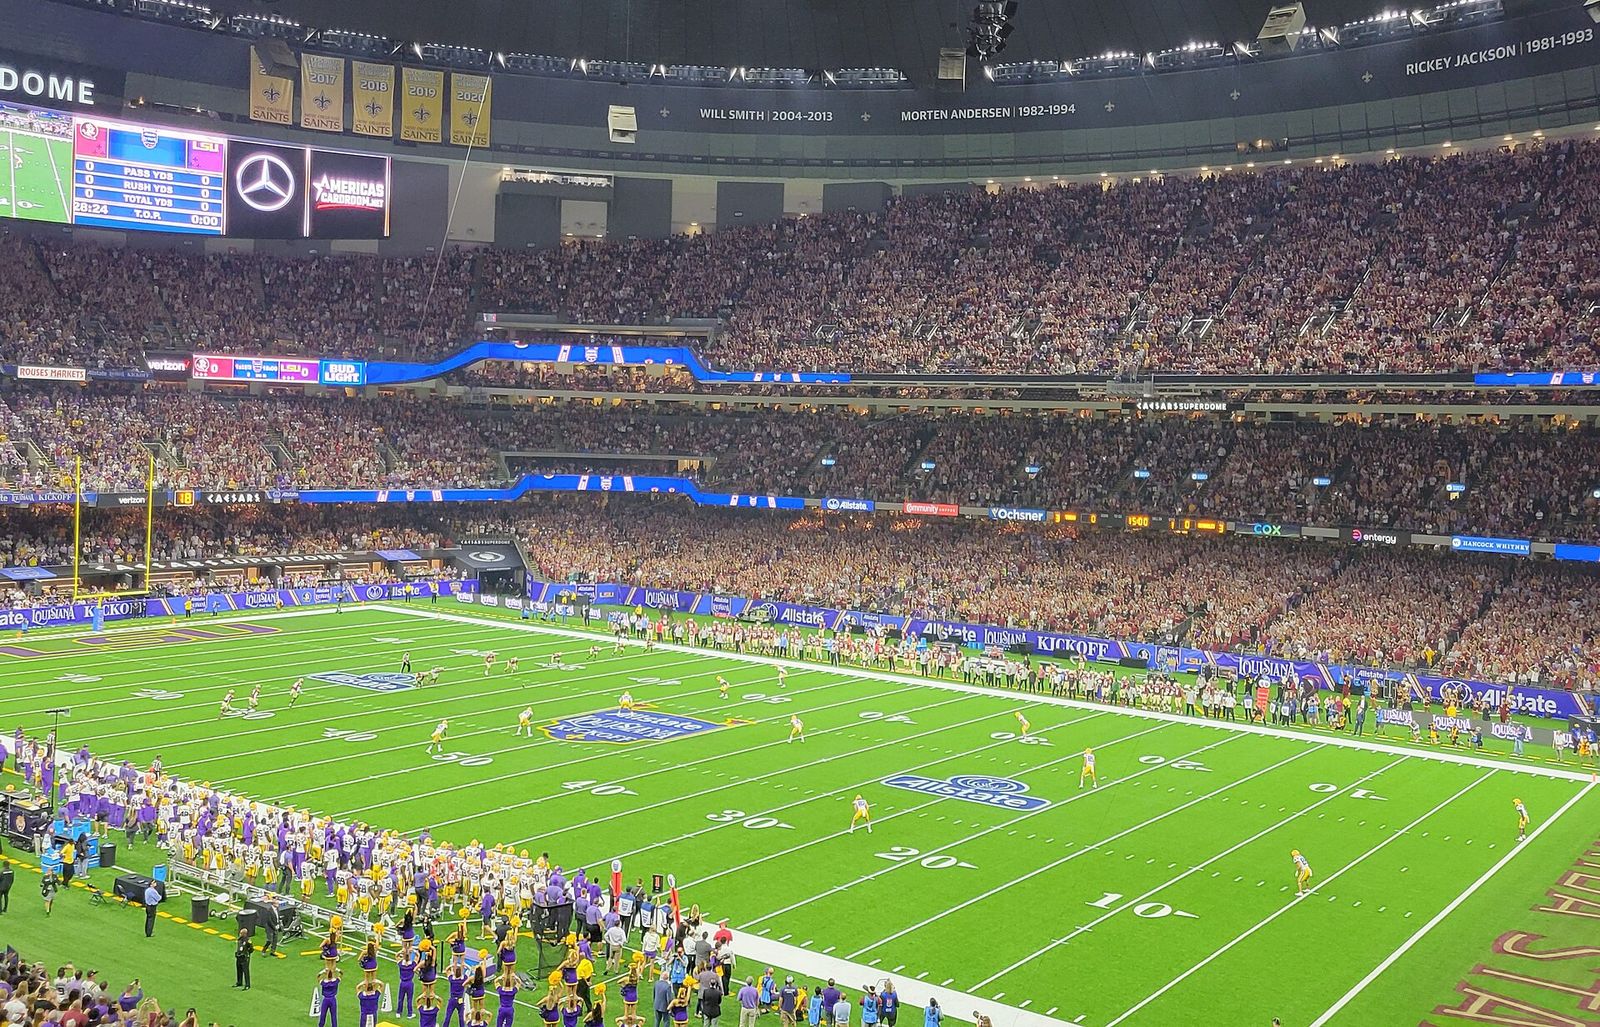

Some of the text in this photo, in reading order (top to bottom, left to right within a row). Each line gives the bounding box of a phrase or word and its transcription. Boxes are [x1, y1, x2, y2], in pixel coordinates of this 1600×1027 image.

[1406, 29, 1594, 75] RICKEY JACKSON 1981-1993
[308, 72, 337, 85] 2017
[0, 67, 95, 105] DOME
[360, 80, 388, 91] 2018
[409, 86, 436, 98] 2019
[253, 111, 290, 122] SAINTS
[700, 109, 833, 122] WILL SMITH 2004-2013
[901, 104, 1076, 121] MORTEN ANDERSEN 1982-1994
[304, 118, 340, 129] SAINTS
[356, 124, 391, 135] SAINTS
[403, 130, 439, 141] SAINTS
[452, 135, 488, 146] SAINTS
[192, 141, 219, 153] LSU
[85, 162, 209, 185] 0 PASS YDS 0
[85, 175, 209, 198] 0 RUSH YDS 0
[313, 173, 384, 198] AMERICAS
[85, 189, 209, 211] 0 TOTAL YDS 0
[74, 202, 218, 225] 28:24 T.O.P. 0:00
[148, 361, 185, 372] verizon
[329, 364, 354, 373] BUD
[19, 368, 48, 377] ROUSES
[50, 369, 84, 380] MARKETS
[325, 371, 359, 382] LIGHT
[1179, 402, 1227, 411] SUPERDOME
[38, 493, 72, 501] KICKOFF
[118, 496, 146, 504] verizon
[207, 494, 260, 503] CAESARS
[906, 502, 938, 514] Community
[998, 509, 1043, 522] Ochsner
[1253, 524, 1281, 535] COX
[1363, 533, 1397, 544] entergy
[1463, 541, 1529, 552] HANCOCK WHITNEY
[645, 590, 679, 608] LOUISIANA
[32, 606, 75, 625] LOUISIANA
[984, 628, 1027, 644] LOUISIANA
[1037, 636, 1109, 656] KICKOFF
[1238, 657, 1295, 677] LOUISIANA
[1357, 670, 1384, 679] Allstate
[432, 751, 493, 766] 50
[563, 779, 613, 797] 40
[889, 779, 1028, 808] Allstate
[706, 809, 779, 829] 30
[875, 846, 958, 869] 20
[1086, 891, 1173, 919] 10
